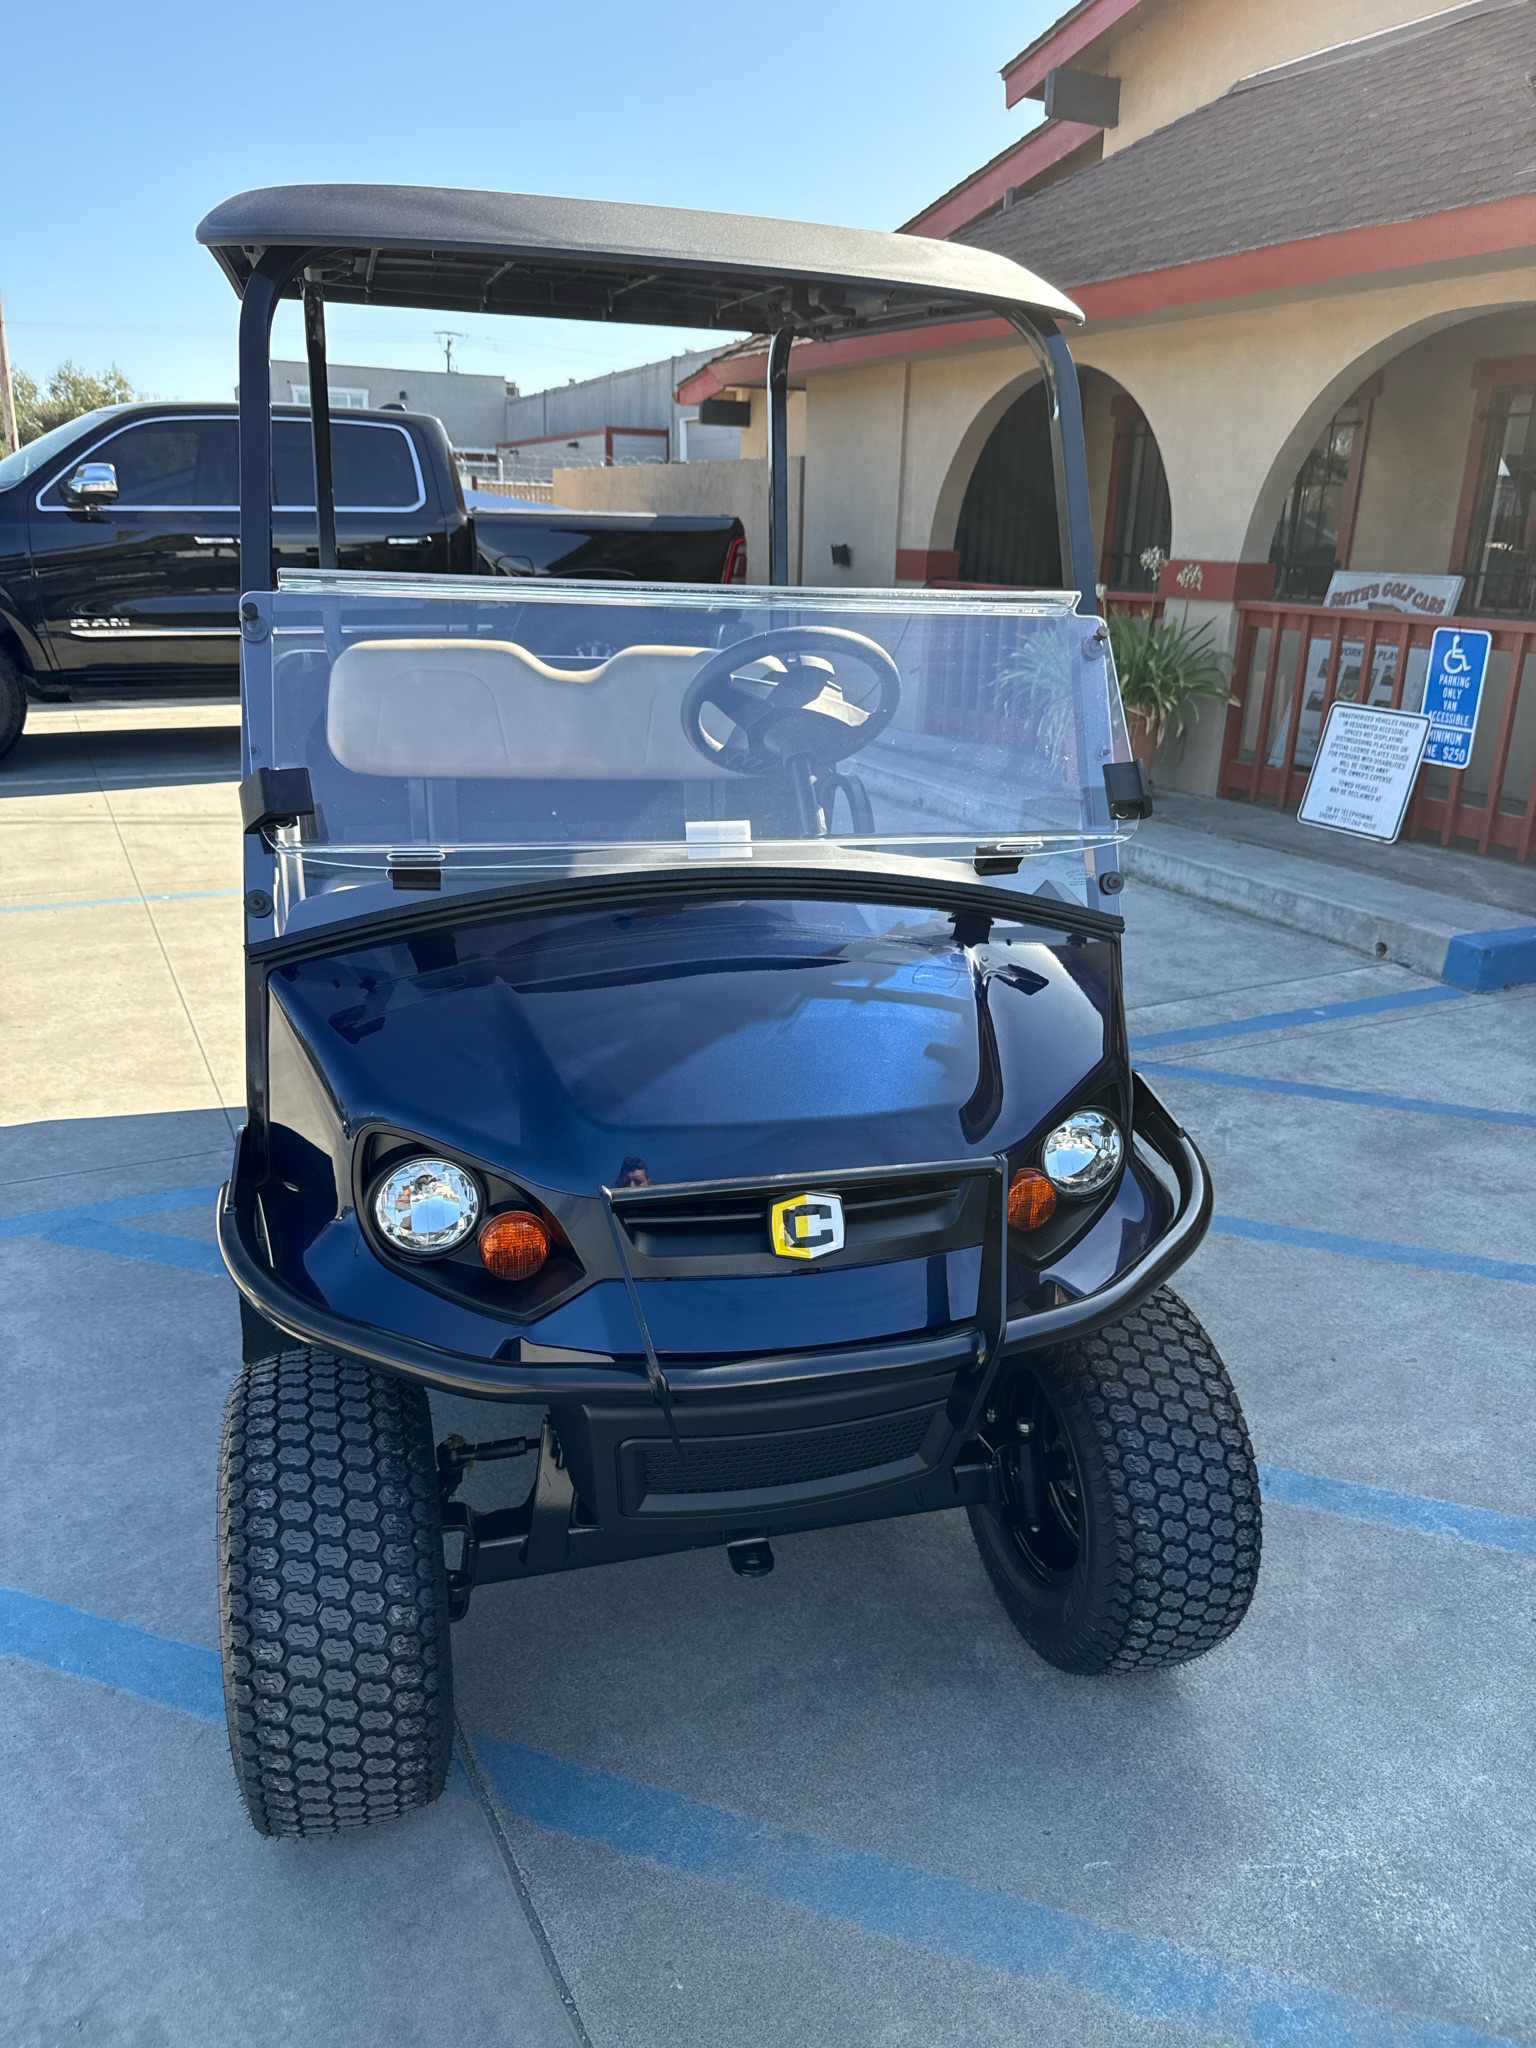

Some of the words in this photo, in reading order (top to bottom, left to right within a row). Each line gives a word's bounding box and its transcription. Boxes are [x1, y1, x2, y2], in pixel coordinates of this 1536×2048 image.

[1329, 583, 1380, 606] SMITH'S
[1381, 581, 1416, 602] GOLF
[1411, 591, 1446, 613] CARS
[70, 617, 130, 627] RAM
[1438, 674, 1471, 689] PARKING
[1442, 688, 1462, 700] ONLY
[1443, 700, 1458, 711] VAN
[1375, 717, 1398, 726] VEHICLES
[1399, 720, 1419, 729] PARKED
[1428, 710, 1470, 726] ACCESSIBLE
[1374, 734, 1403, 743] DISPLAYING
[1330, 743, 1348, 751] SPECIAL
[1350, 746, 1370, 754] LICENSE
[1371, 750, 1389, 758] PLATES
[1390, 753, 1409, 761] ISSUED
[1373, 742, 1399, 751] PLACARDS
[1339, 753, 1360, 761] PERSONS
[1425, 744, 1437, 758] NE
[1442, 746, 1466, 763] $250
[1370, 774, 1392, 783] EXPENSE
